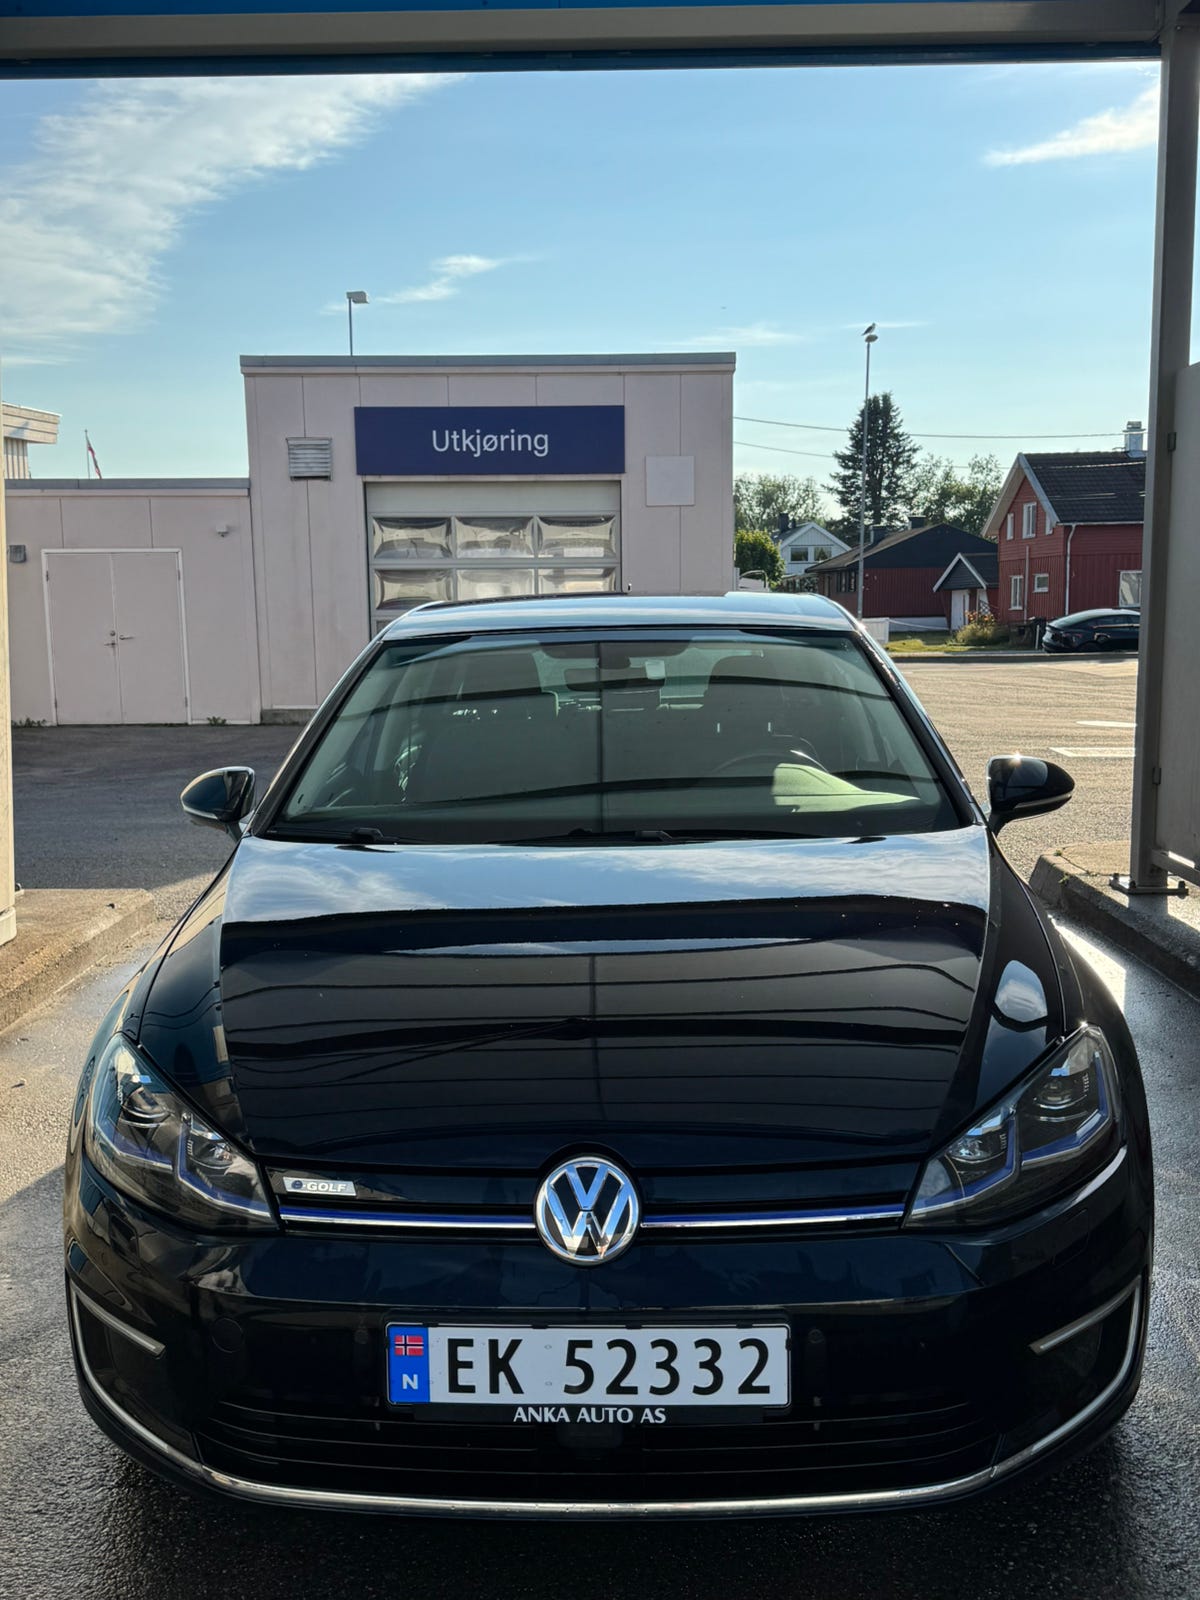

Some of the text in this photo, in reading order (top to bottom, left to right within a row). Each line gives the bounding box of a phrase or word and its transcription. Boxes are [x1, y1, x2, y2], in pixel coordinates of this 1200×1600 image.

[432, 428, 549, 458] Utkjøring
[447, 1338, 771, 1396] EK 52332
[402, 1374, 418, 1390] N
[513, 1406, 667, 1424] ANKA AUTO AS
